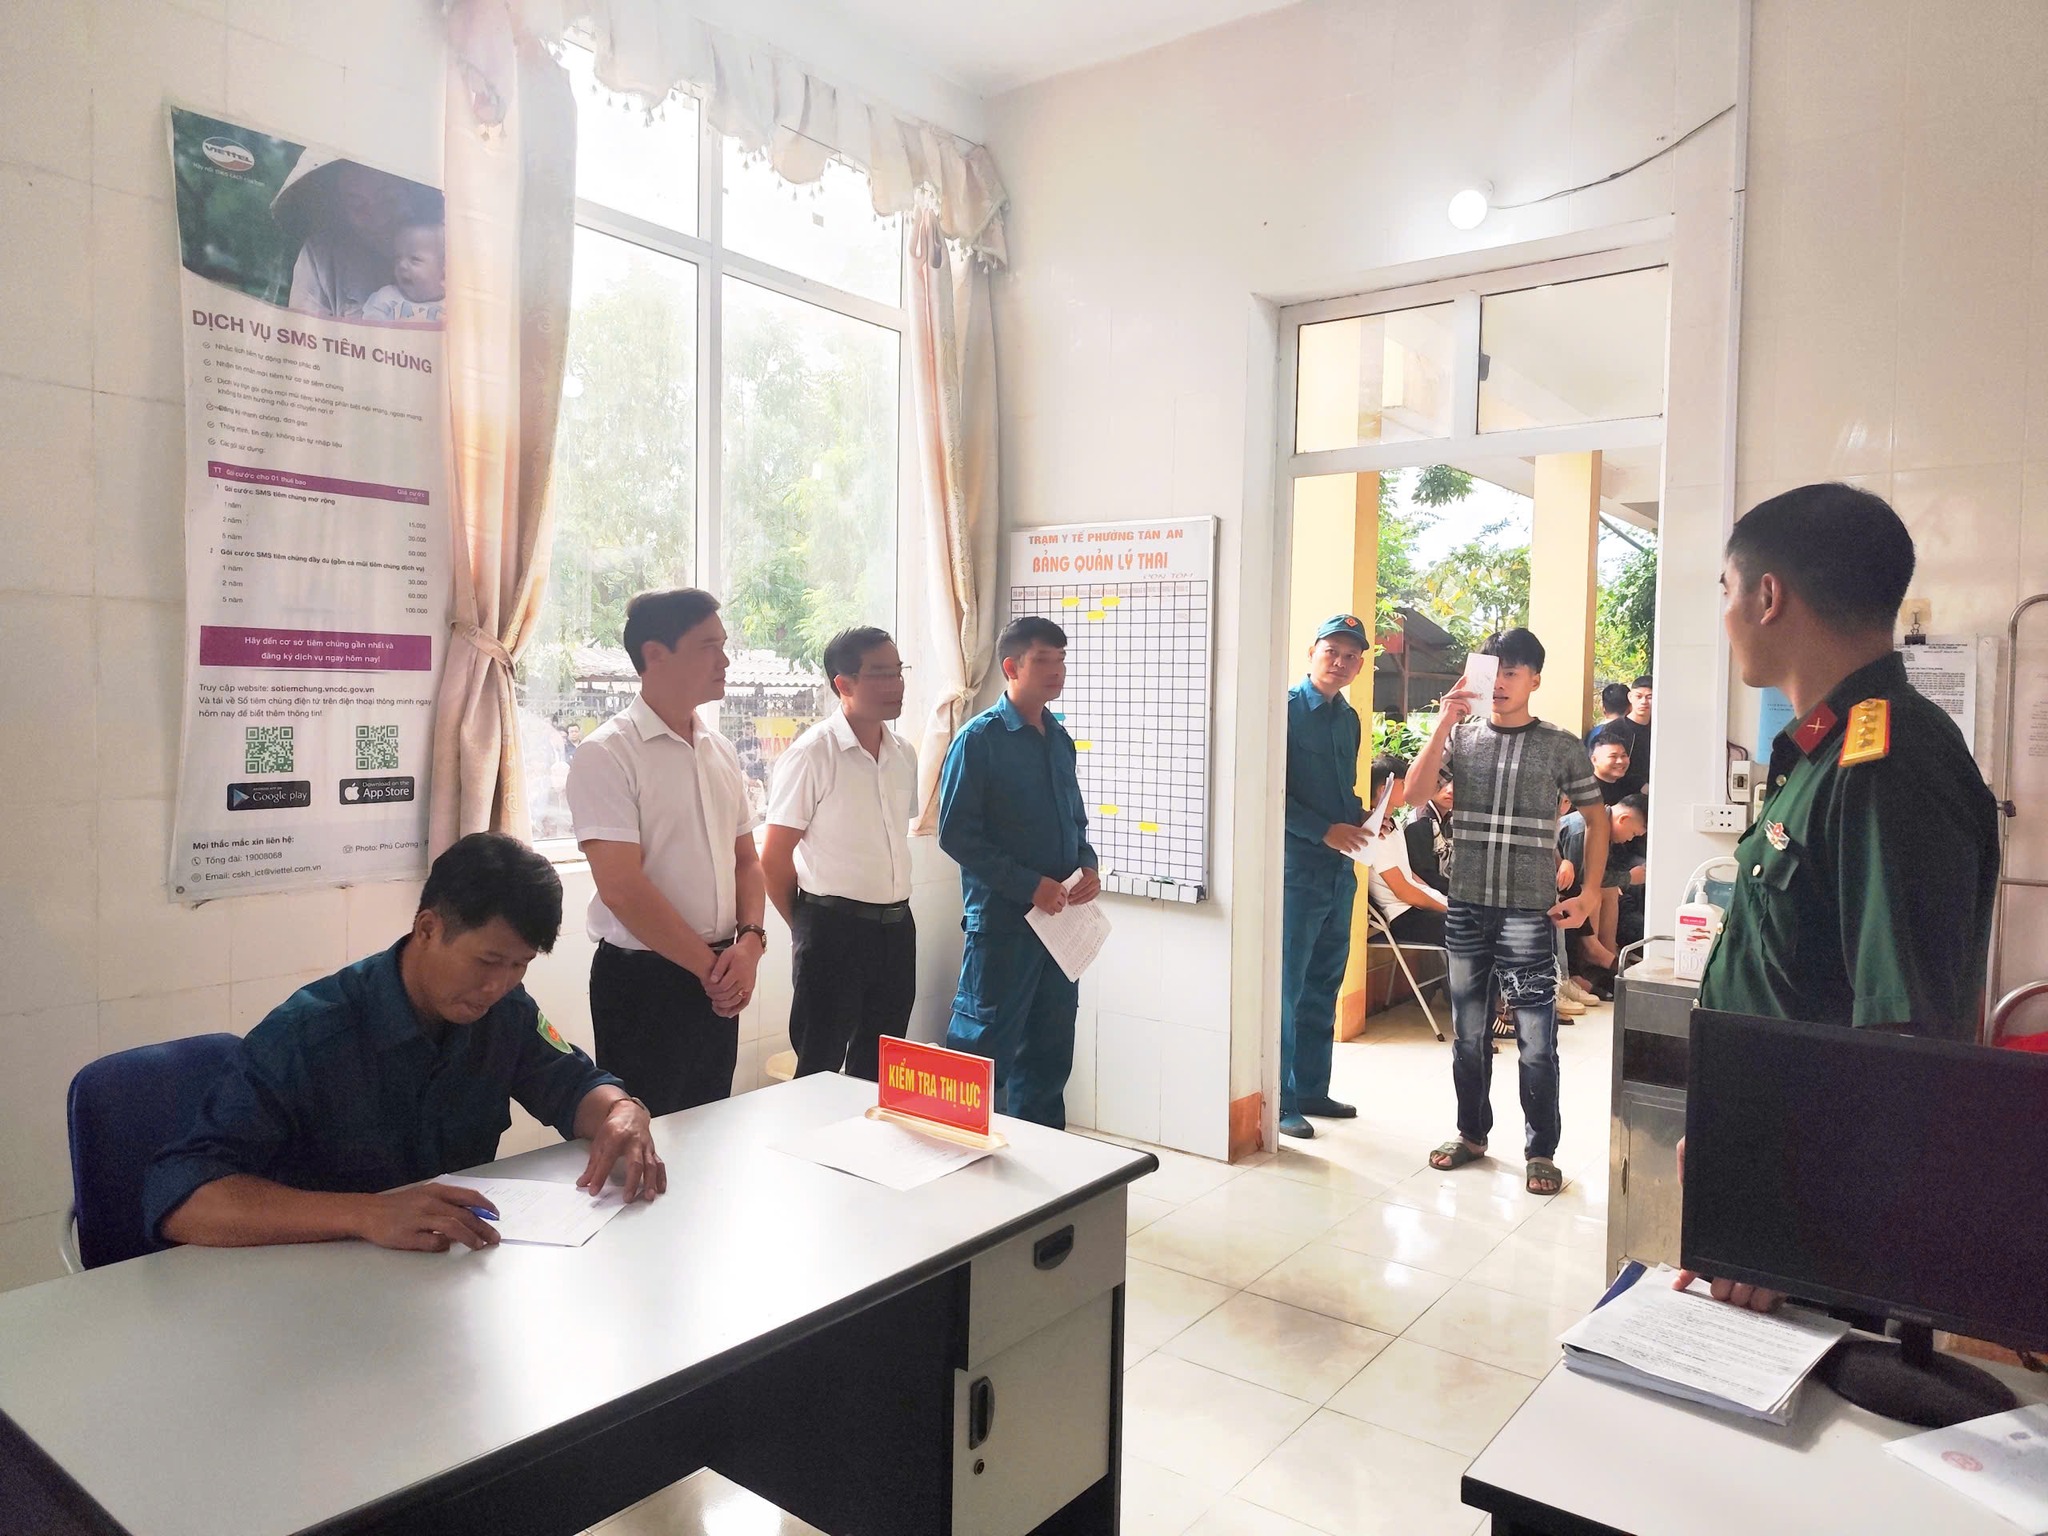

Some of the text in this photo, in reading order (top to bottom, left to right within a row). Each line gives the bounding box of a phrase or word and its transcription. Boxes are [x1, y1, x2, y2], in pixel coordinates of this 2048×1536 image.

[205, 144, 252, 163] VIETTEL
[192, 310, 244, 334] DỊCH
[249, 320, 271, 343] VỤ
[276, 328, 318, 350] SMS
[322, 338, 366, 360] TIÊM
[213, 466, 222, 474] TT
[256, 473, 270, 481] cho
[294, 478, 307, 486] bao
[255, 489, 272, 497] SMS
[272, 490, 287, 499] tiêm
[1028, 534, 1058, 546] TRẠM
[1062, 534, 1068, 543] Y
[1071, 530, 1084, 543] TẾ
[1087, 530, 1134, 542] PHƯỜNG
[1166, 529, 1184, 539] AN
[220, 548, 233, 556] Gói
[256, 551, 272, 559] SMS
[401, 564, 415, 572] dịch
[1032, 548, 1168, 573] BẢNG QUẢN LÝ THAI
[228, 596, 244, 604] năm
[244, 636, 261, 646] Hãy
[262, 636, 277, 645] đến
[306, 638, 324, 647] tiêm
[351, 640, 366, 649] gần
[368, 640, 384, 649] nhất
[385, 642, 394, 650] và
[261, 652, 281, 662] đăng
[283, 652, 293, 662] ký
[294, 652, 313, 662] dịch
[313, 654, 323, 663] vụ
[325, 655, 344, 663] ngay
[345, 654, 363, 662] hôm
[199, 683, 375, 694] Truy cập website: sotiemchung.vncdc.gov.vn
[198, 696, 210, 705] Và
[225, 696, 236, 705] về
[250, 696, 267, 705] tiêm
[294, 696, 311, 706] điện
[339, 697, 356, 706] điện
[356, 697, 375, 706] thoại
[376, 698, 395, 707] thông
[415, 699, 432, 707] ngay
[198, 710, 219, 718] hôm
[220, 711, 236, 719] nay
[237, 709, 248, 718] để
[249, 709, 264, 718] biết
[263, 709, 286, 718] thêm
[287, 710, 309, 718] thông
[362, 780, 391, 788] Download
[252, 790, 308, 804] Google play
[362, 786, 410, 800] App Store
[192, 835, 295, 851] Mọi thắc mắc xin liên hệ:
[205, 852, 283, 865] Tổng đài: 19008068
[205, 873, 230, 881] Email:
[888, 1058, 981, 1113] KIỂM TRA THỊ LỰC
